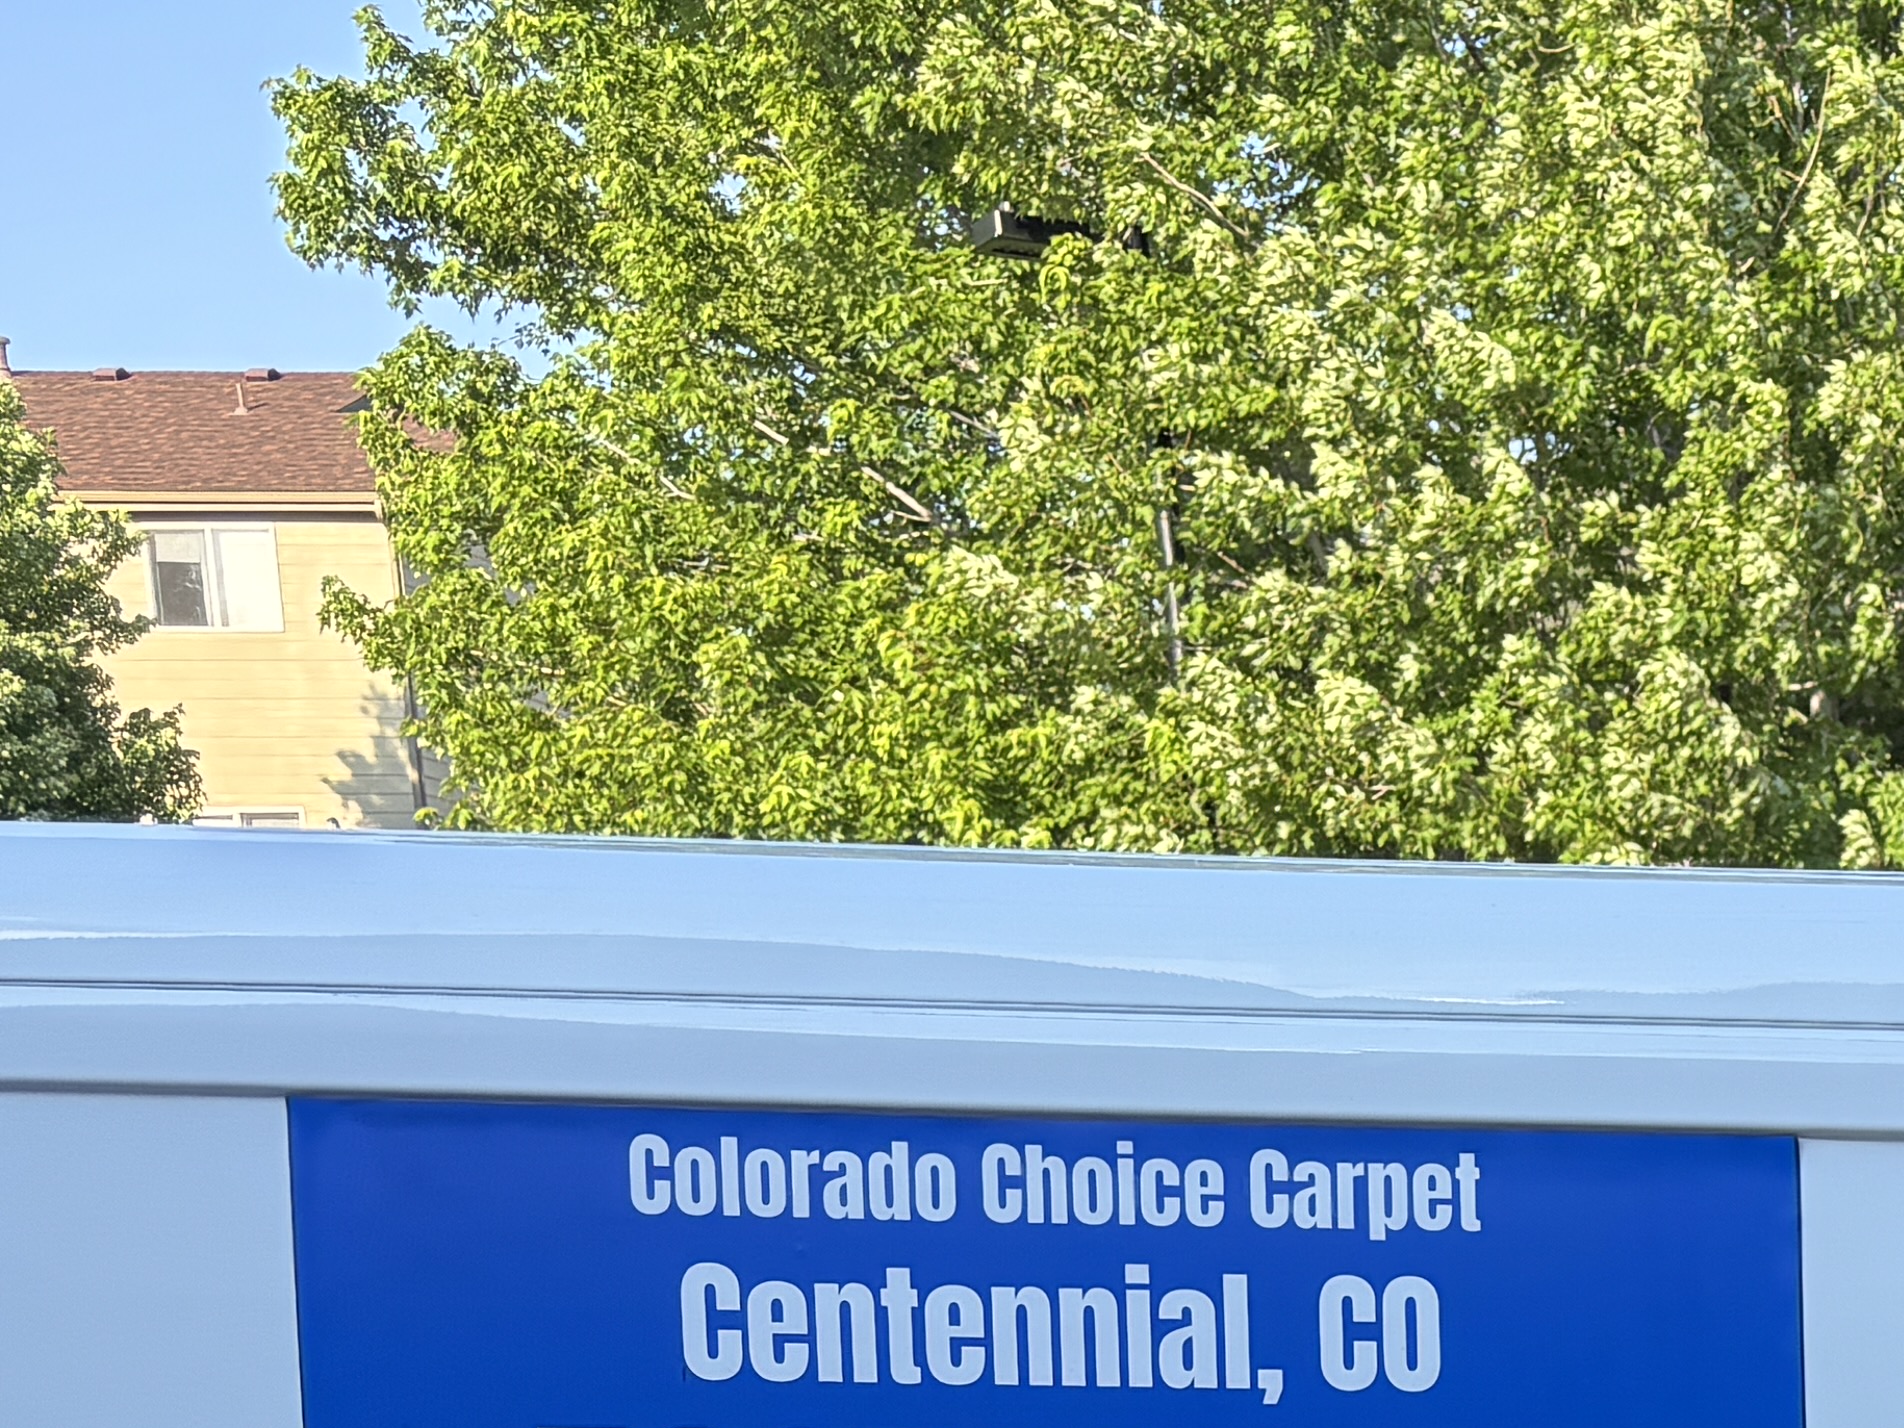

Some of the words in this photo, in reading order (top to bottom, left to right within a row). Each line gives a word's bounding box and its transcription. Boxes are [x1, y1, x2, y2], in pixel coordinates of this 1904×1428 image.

[628, 1133, 958, 1225] Colorado
[980, 1140, 1228, 1232] Choice
[1248, 1147, 1484, 1242] Carpet
[680, 1262, 1284, 1405] Centennial,
[1318, 1274, 1442, 1394] CO
